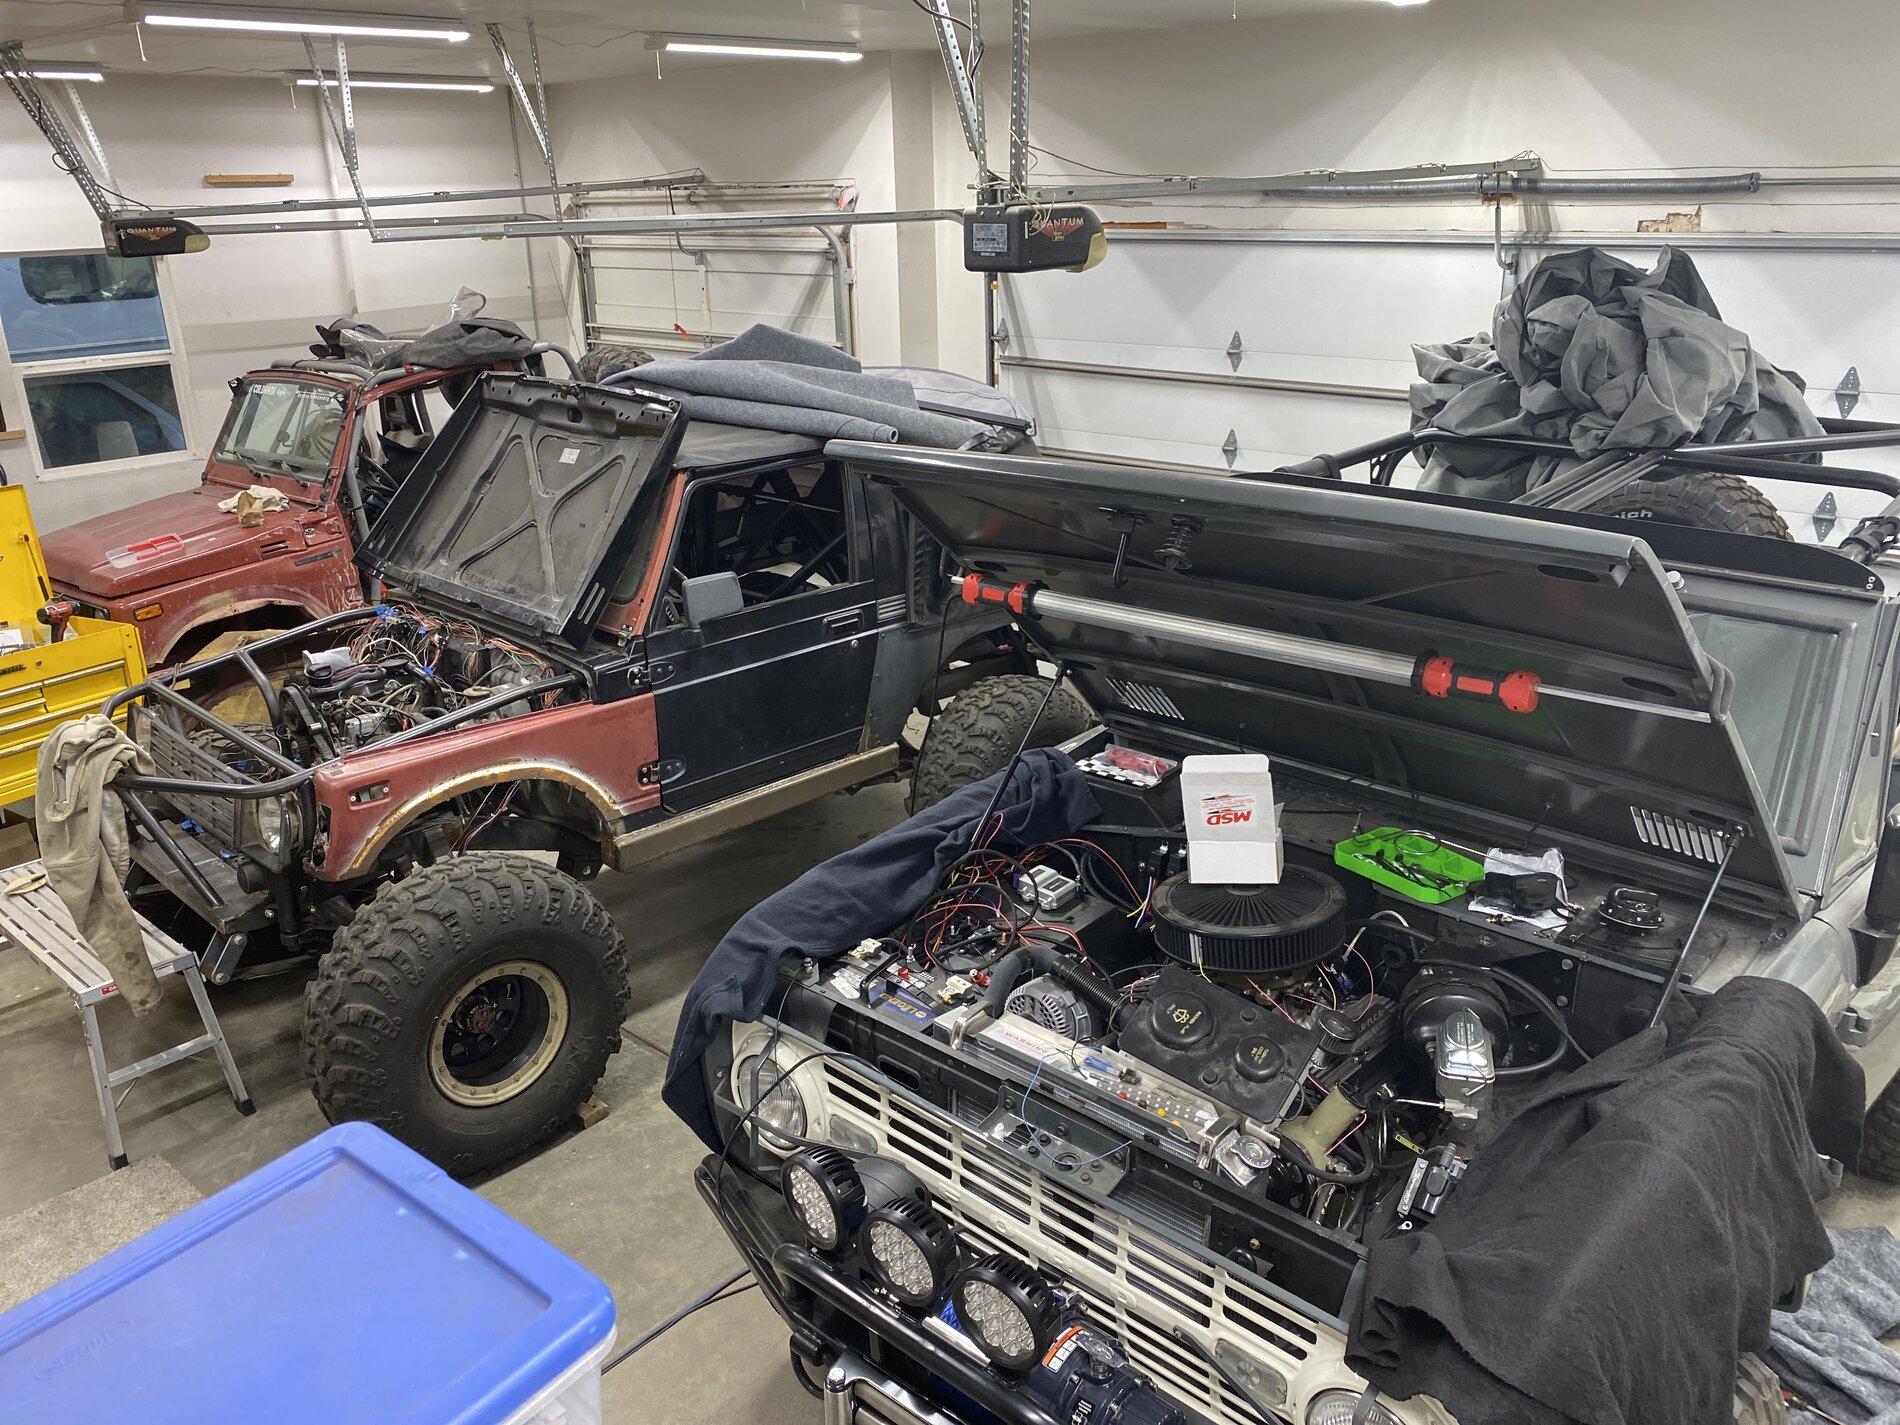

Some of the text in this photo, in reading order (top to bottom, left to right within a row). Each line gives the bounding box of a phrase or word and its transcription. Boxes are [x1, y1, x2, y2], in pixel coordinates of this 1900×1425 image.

[1031, 217, 1084, 228] QUANTUM
[1206, 810, 1252, 826] MSD
[1004, 1031, 1049, 1054] WARNING
